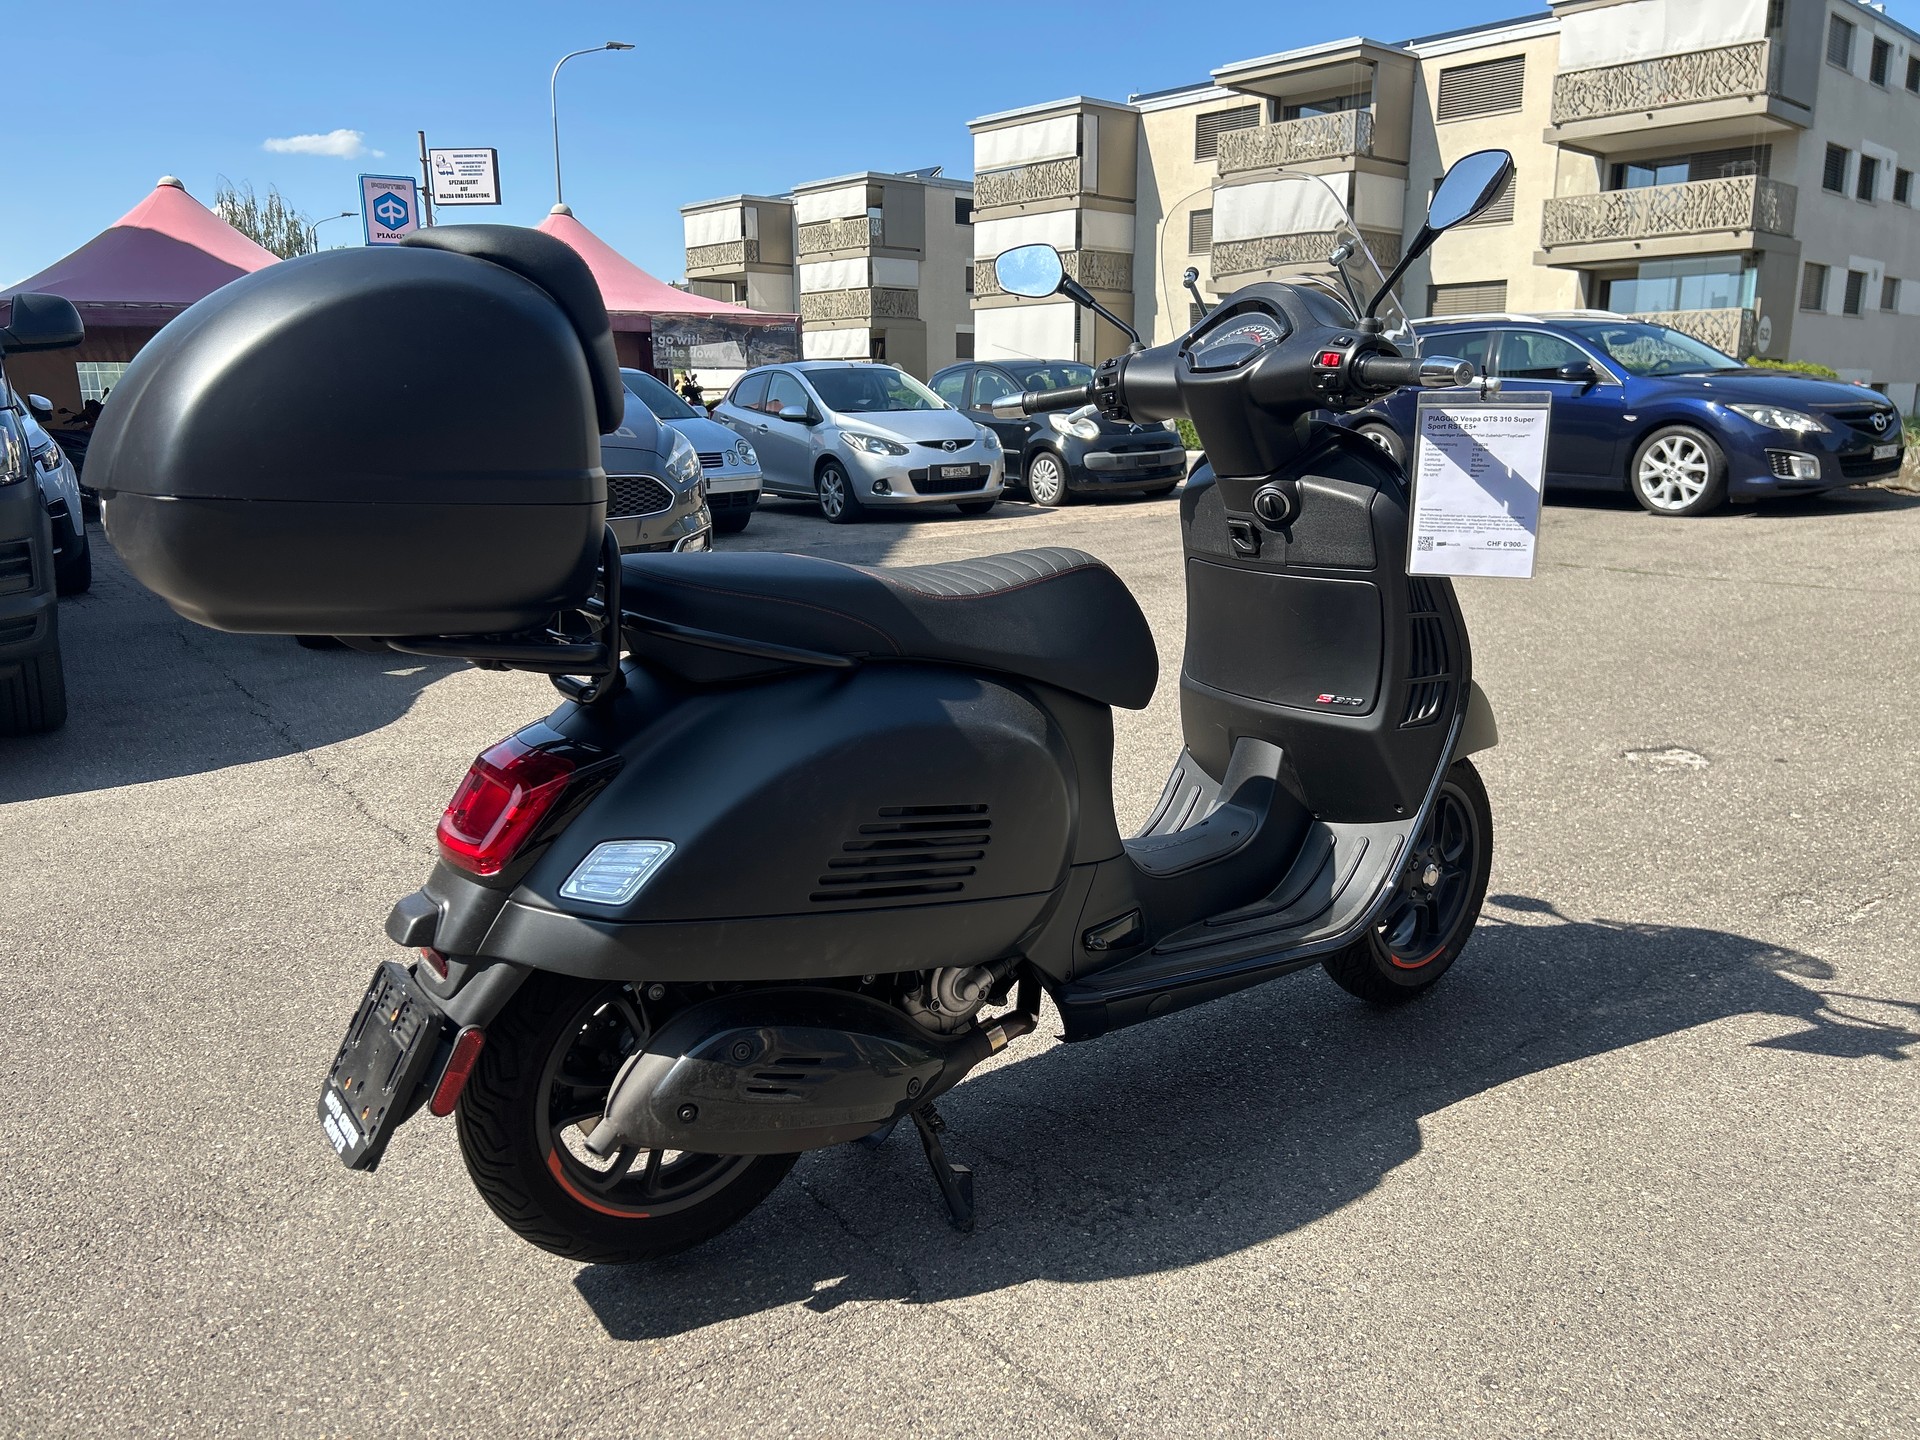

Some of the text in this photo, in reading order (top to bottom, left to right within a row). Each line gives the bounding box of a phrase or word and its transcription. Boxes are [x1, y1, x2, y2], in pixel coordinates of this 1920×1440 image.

[370, 182, 407, 190] PORTER
[376, 232, 406, 240] PIAGG
[657, 333, 703, 347] go with
[664, 345, 714, 358] the flow
[324, 1090, 359, 1150] MOTO CENTER
